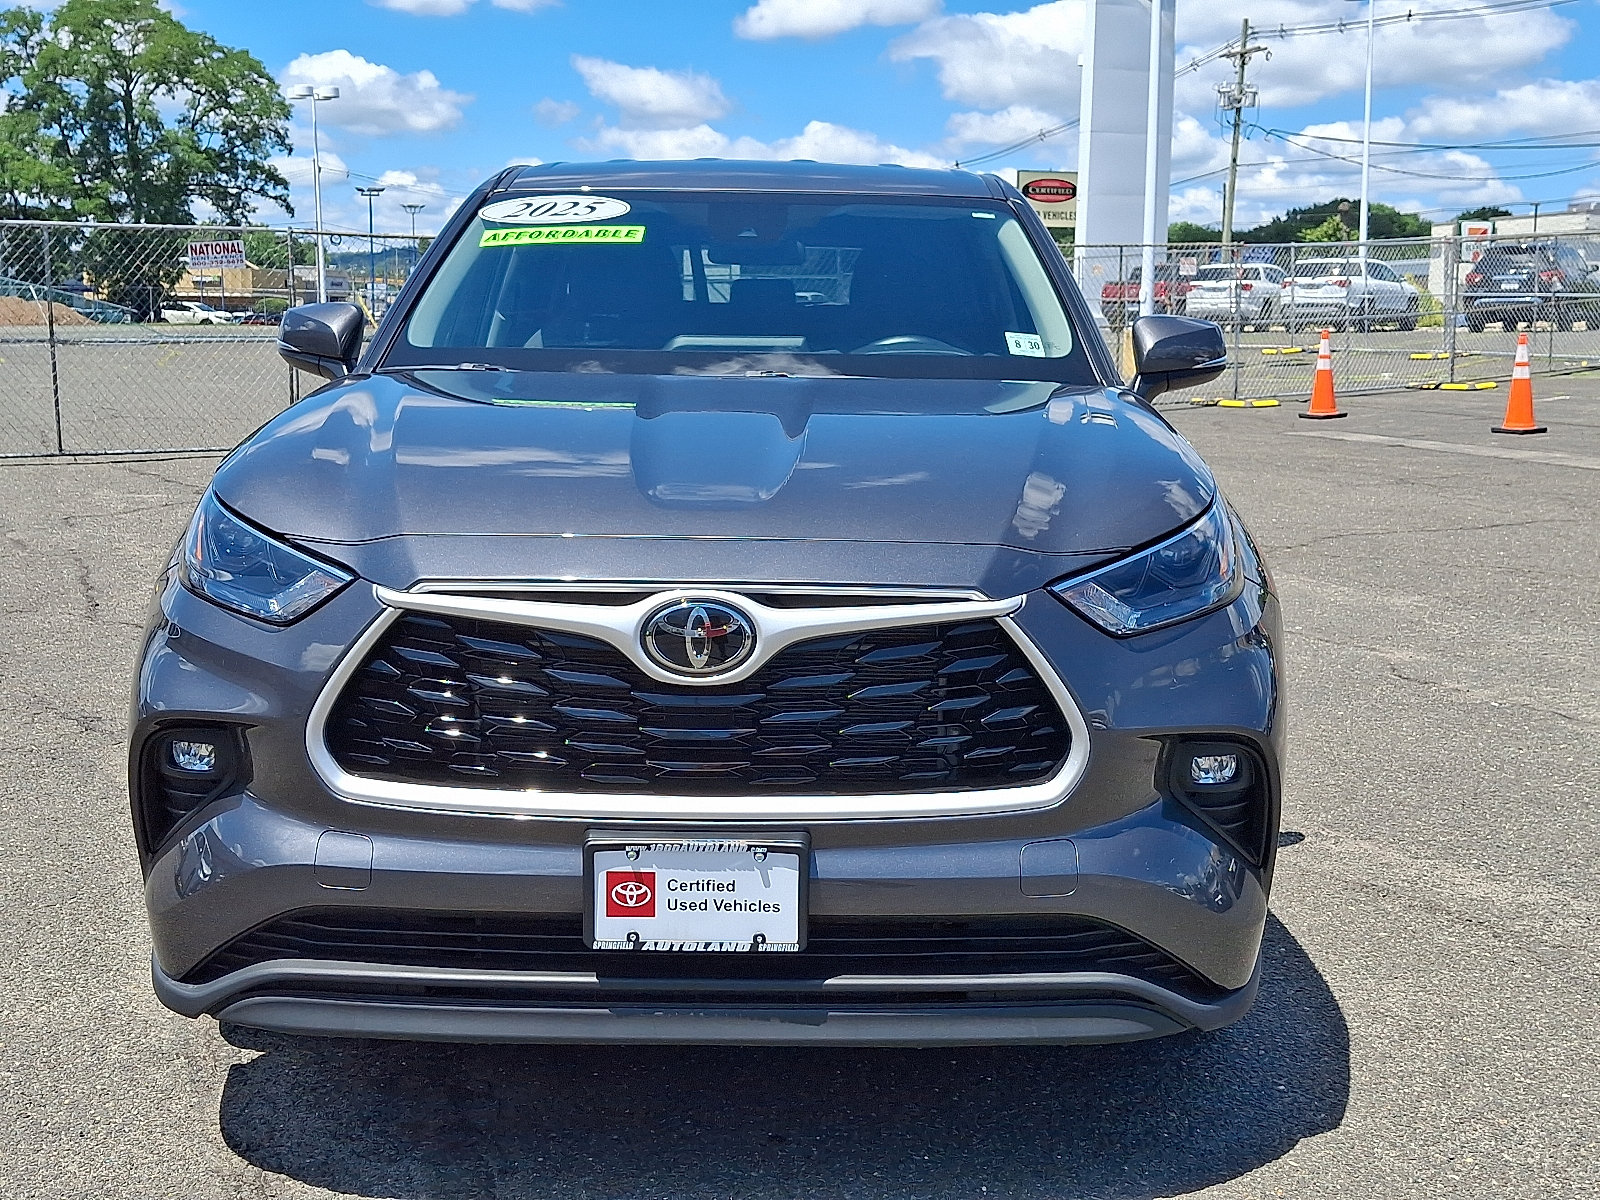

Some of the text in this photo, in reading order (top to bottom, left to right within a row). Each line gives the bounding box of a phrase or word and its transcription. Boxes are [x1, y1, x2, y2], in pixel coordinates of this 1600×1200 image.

[501, 201, 607, 219] 2025
[484, 229, 640, 243] AFFORDABLE
[190, 241, 244, 256] NATIONAL
[1014, 339, 1041, 350] 8 30
[667, 878, 736, 893] Certified
[667, 898, 781, 913] Used Vehicles
[592, 940, 800, 952] SPRINGFIELD AUTOLAND SPRINGFIELD
